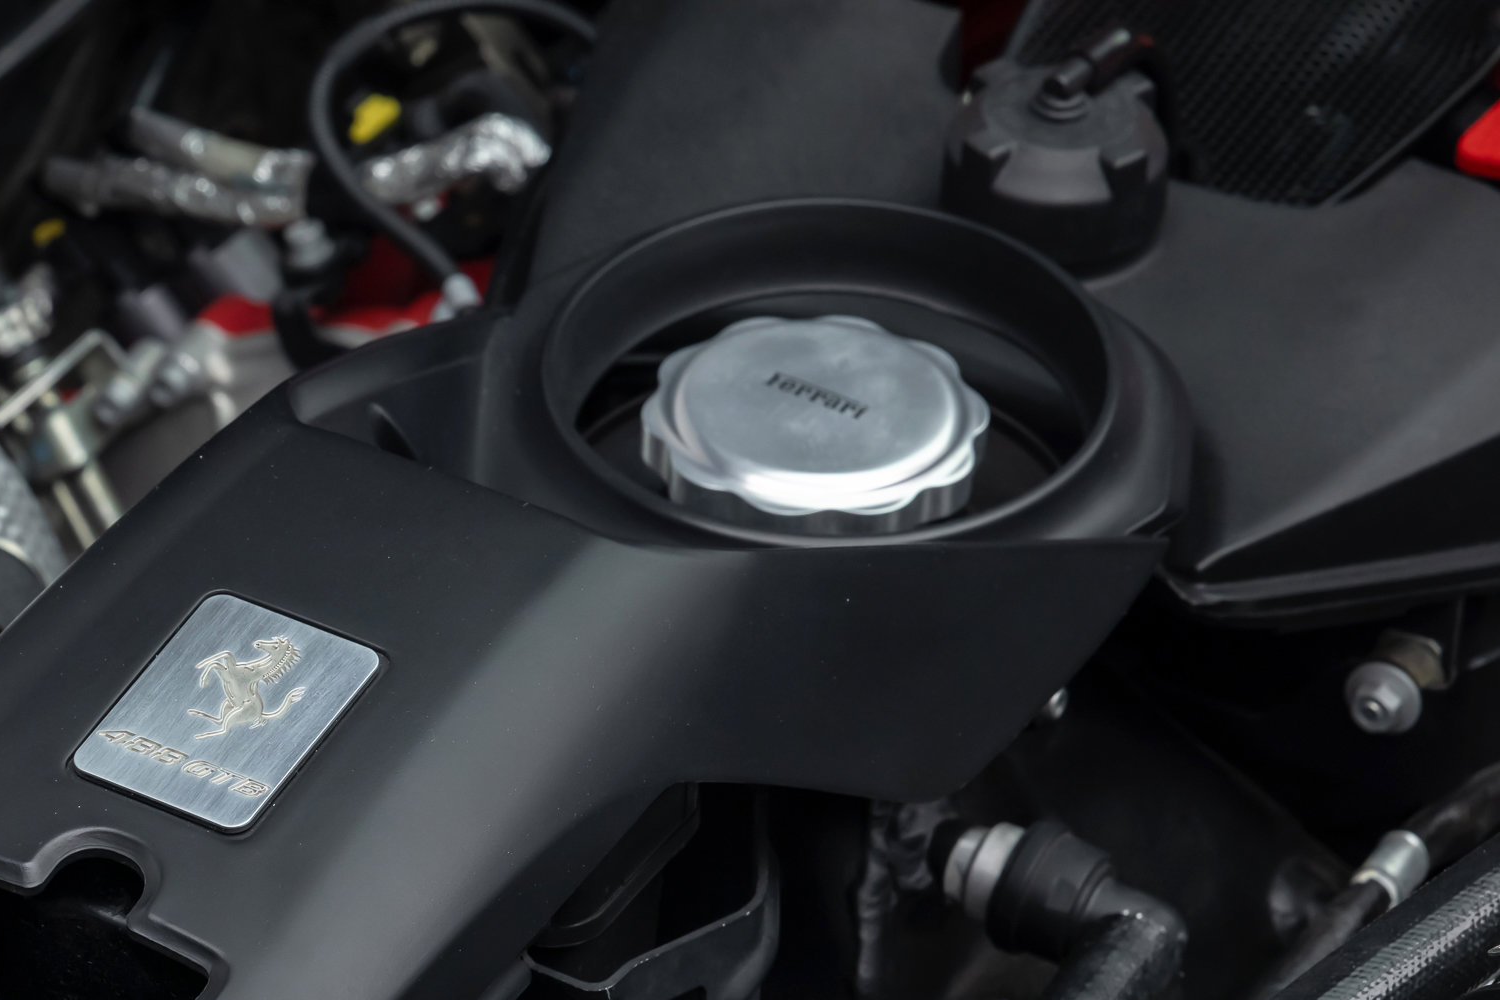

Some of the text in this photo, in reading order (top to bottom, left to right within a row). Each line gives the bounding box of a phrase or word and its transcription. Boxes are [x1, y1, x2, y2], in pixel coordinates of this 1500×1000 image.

[764, 372, 868, 420] Ferrari
[98, 729, 271, 798] 488 GTB
